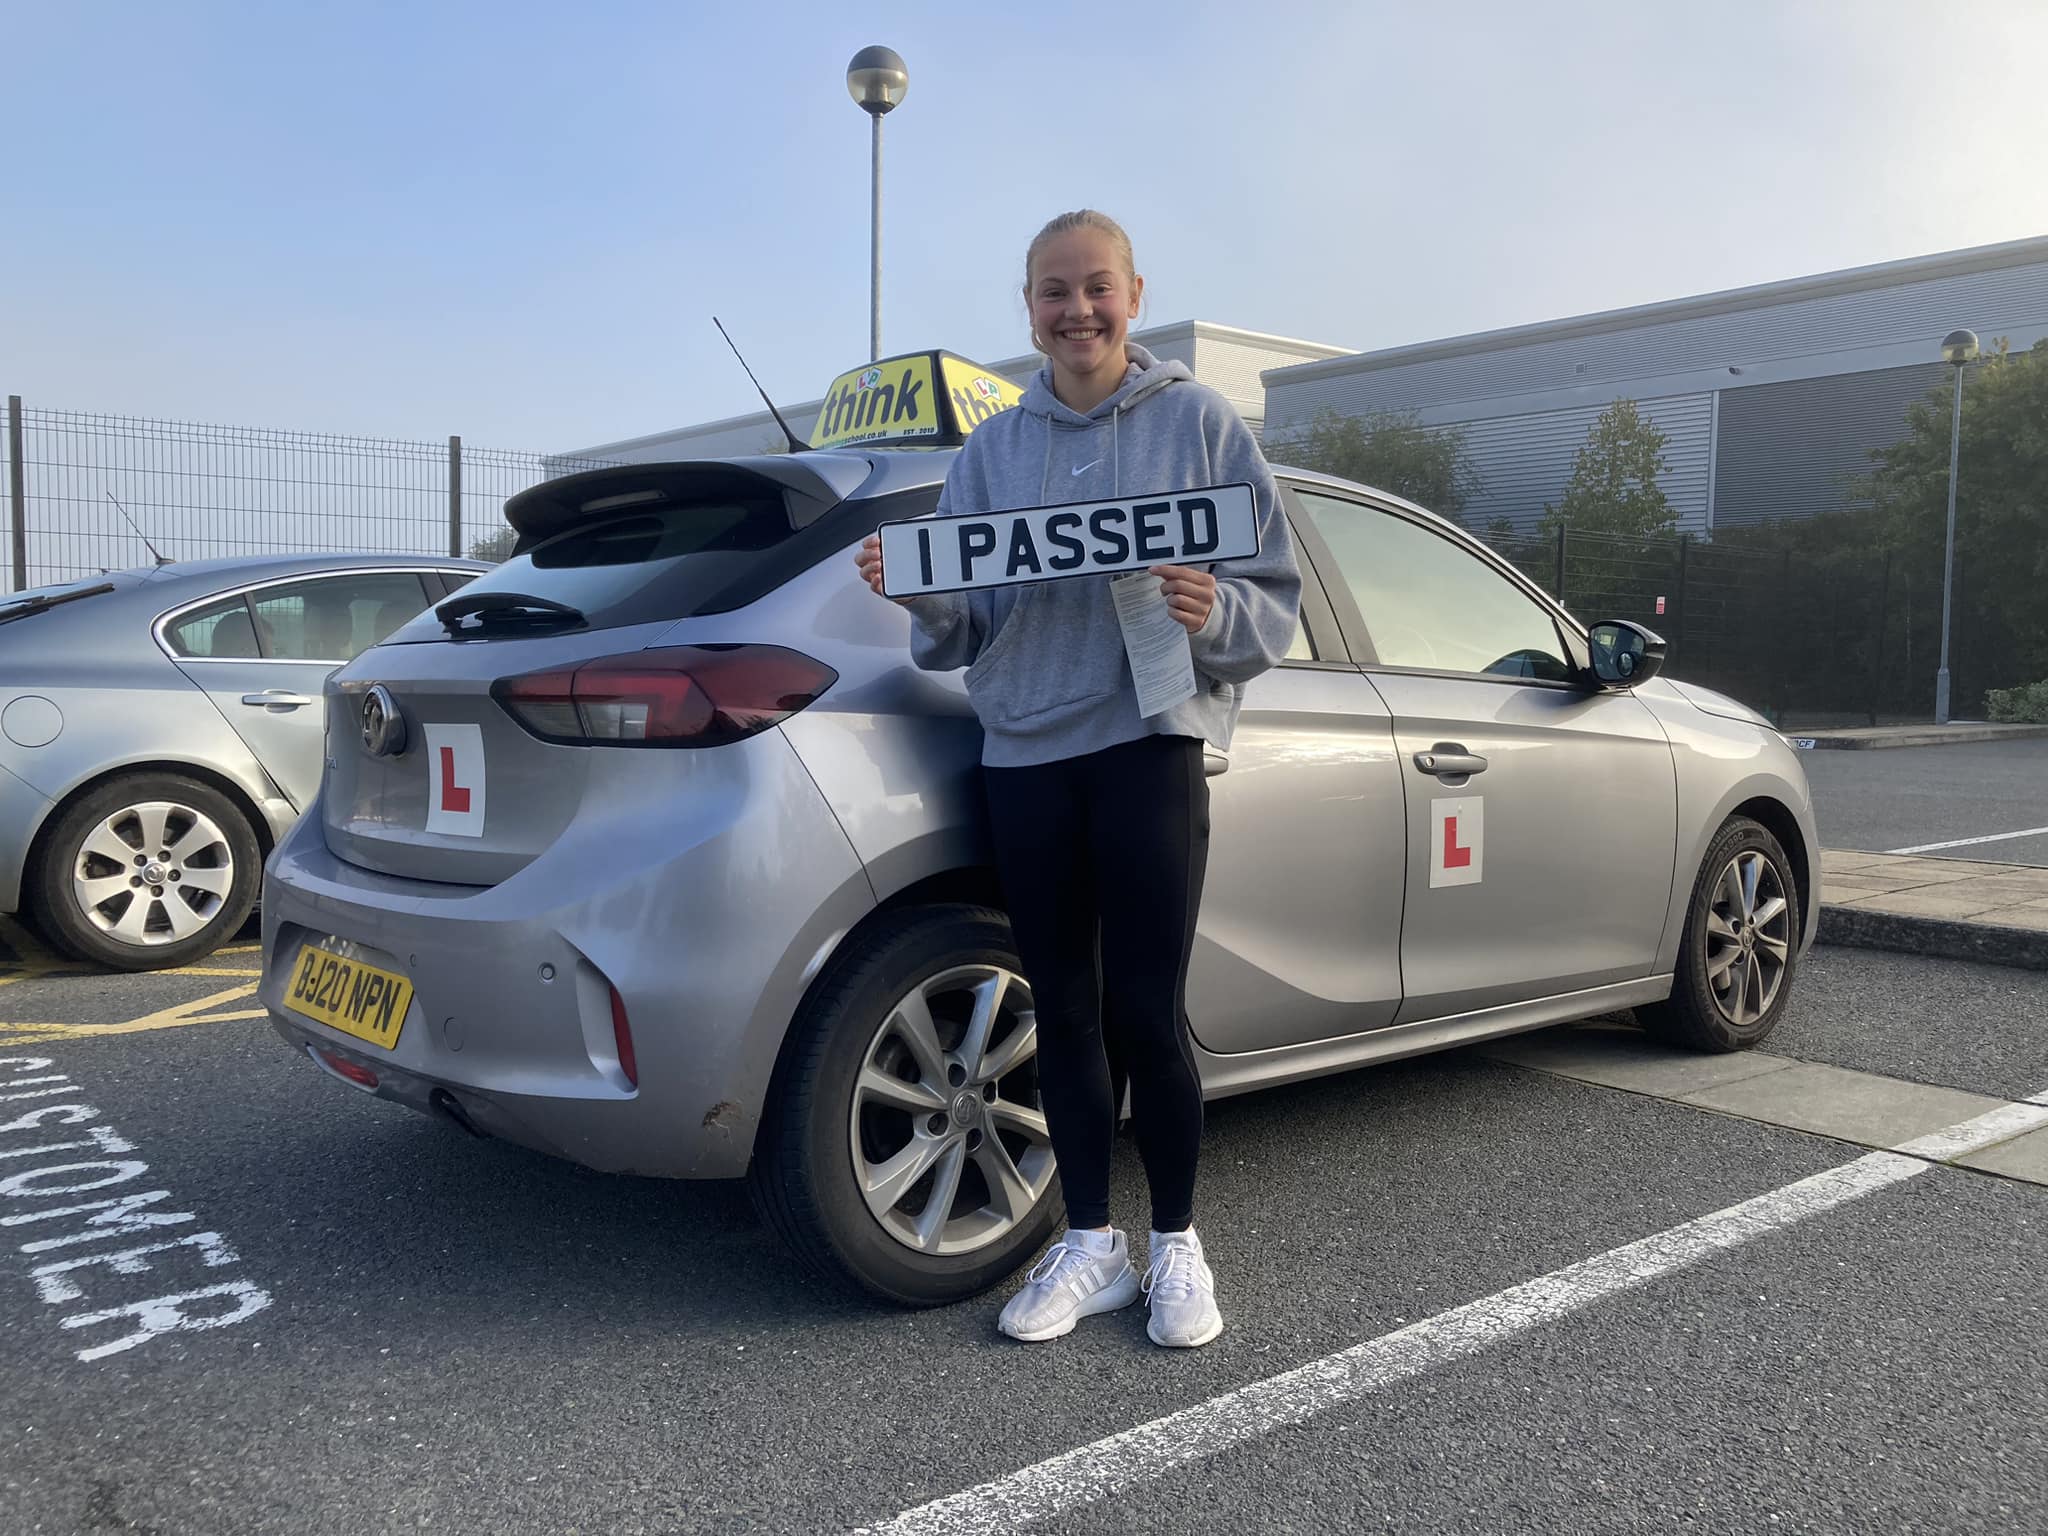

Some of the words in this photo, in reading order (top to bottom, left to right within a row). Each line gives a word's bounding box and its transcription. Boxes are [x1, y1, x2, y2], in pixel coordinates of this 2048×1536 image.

[822, 368, 923, 439] think
[917, 528, 934, 586] I
[957, 497, 1220, 582] PASSED
[440, 746, 471, 813] L
[1443, 816, 1471, 869] L
[293, 952, 352, 1013] BJ20
[343, 968, 403, 1034] NPN
